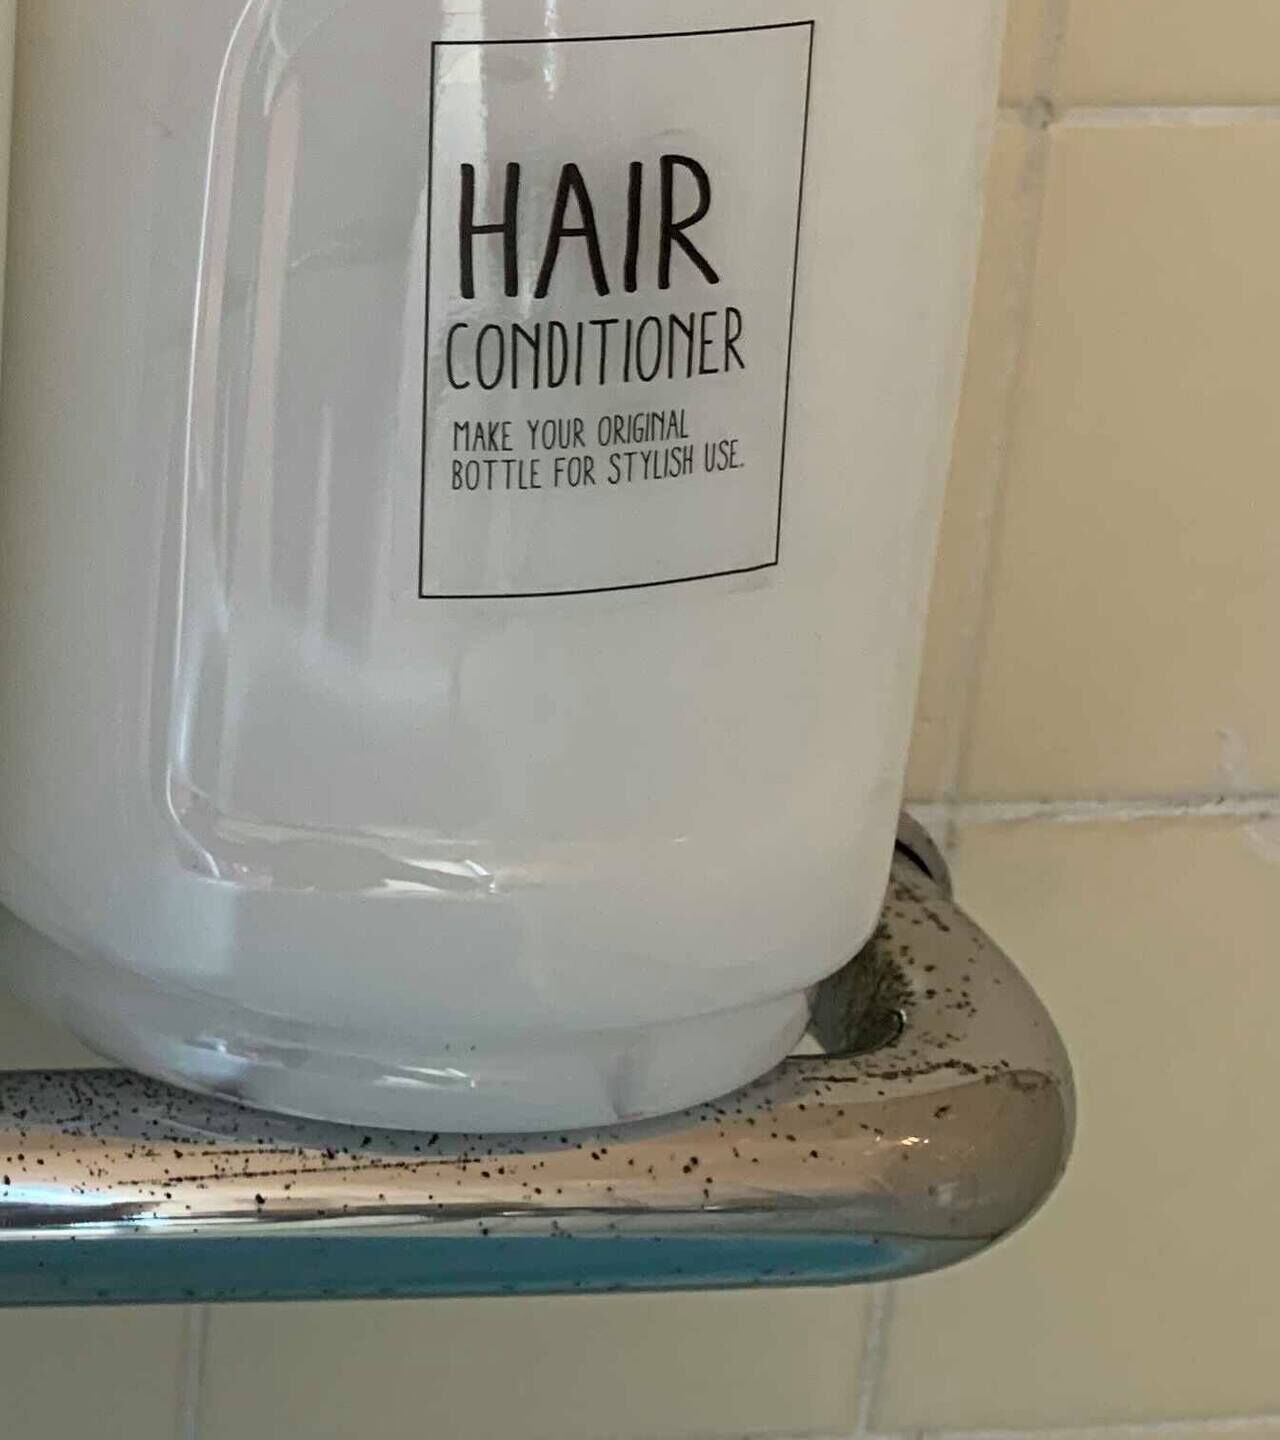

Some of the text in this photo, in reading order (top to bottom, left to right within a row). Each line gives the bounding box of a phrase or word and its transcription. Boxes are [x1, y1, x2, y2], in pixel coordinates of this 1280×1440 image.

[459, 154, 720, 299] HAIR
[445, 306, 746, 390] CONDITIONER
[453, 408, 689, 452] MAKE YOUR ORIGINAL
[452, 438, 745, 491] BOTTLE FOR STYLISH USE.
